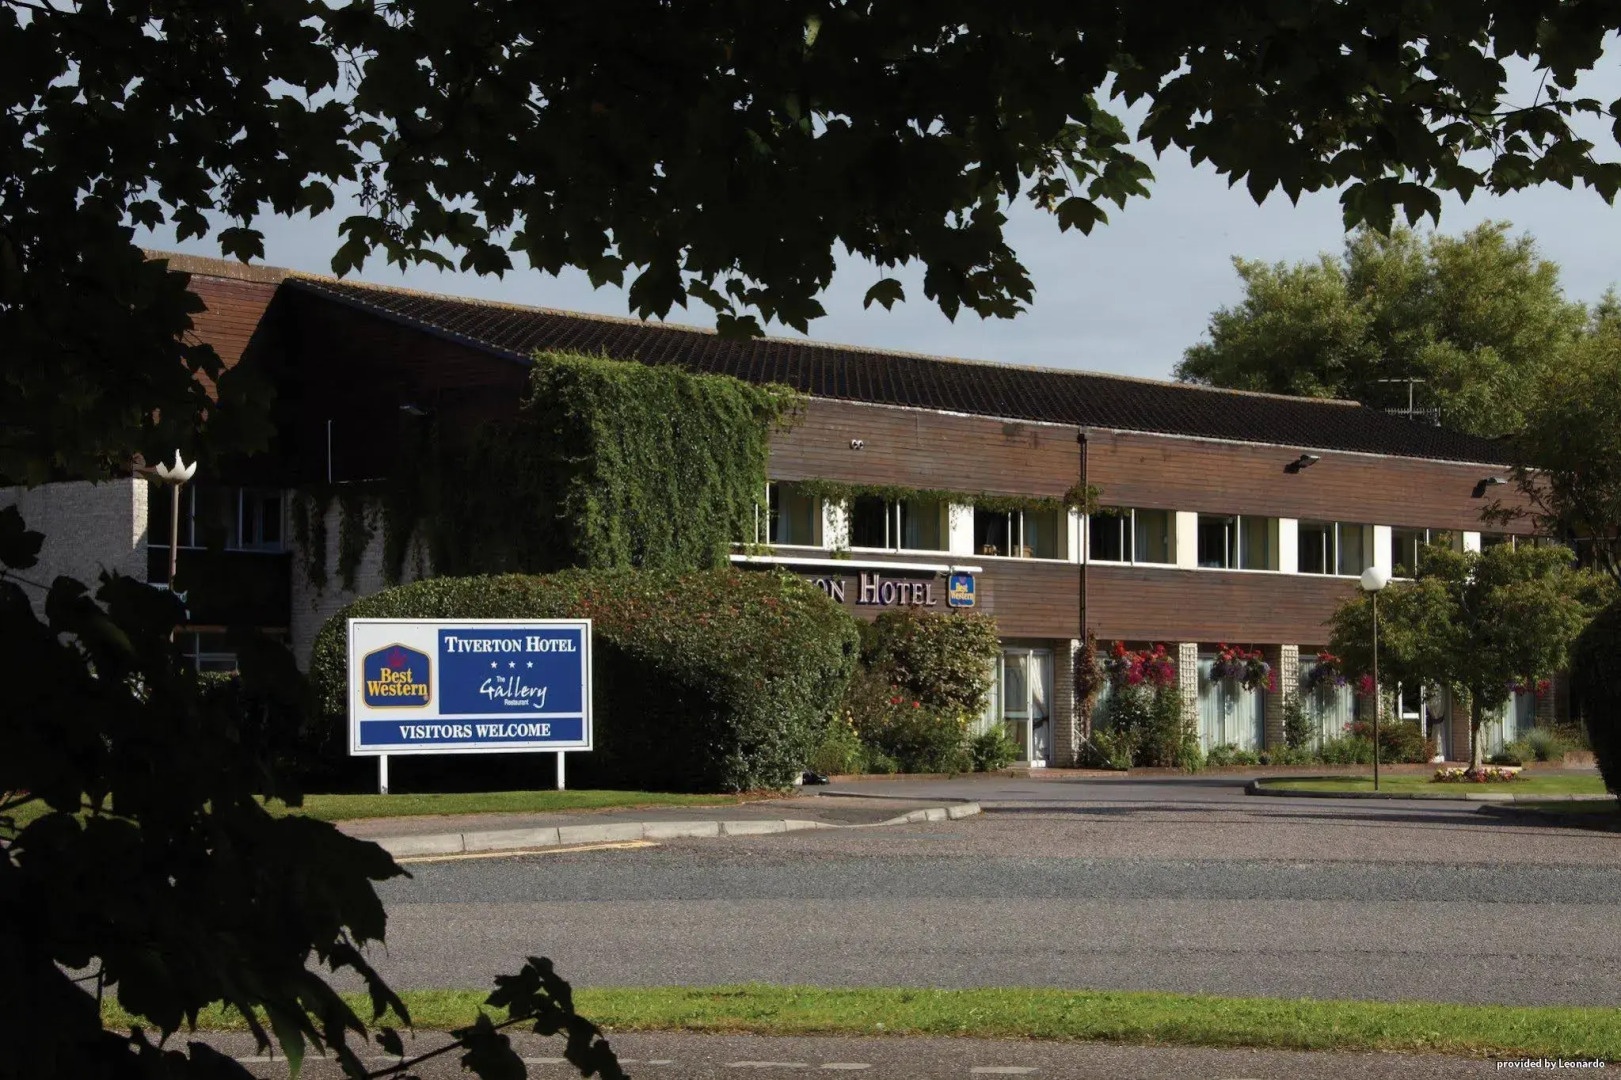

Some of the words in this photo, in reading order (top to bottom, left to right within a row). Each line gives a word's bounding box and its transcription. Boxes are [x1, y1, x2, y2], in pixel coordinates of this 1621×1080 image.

[859, 571, 937, 605] HOTEL
[444, 636, 522, 653] TIVERTON
[525, 636, 576, 652] HOTEL
[380, 667, 413, 684] Best
[496, 675, 506, 683] The
[366, 680, 429, 697] Western
[479, 676, 547, 709] Gallery
[504, 698, 530, 706] Restaurant
[399, 724, 473, 740] VISITORS
[475, 723, 551, 738] WELCOME
